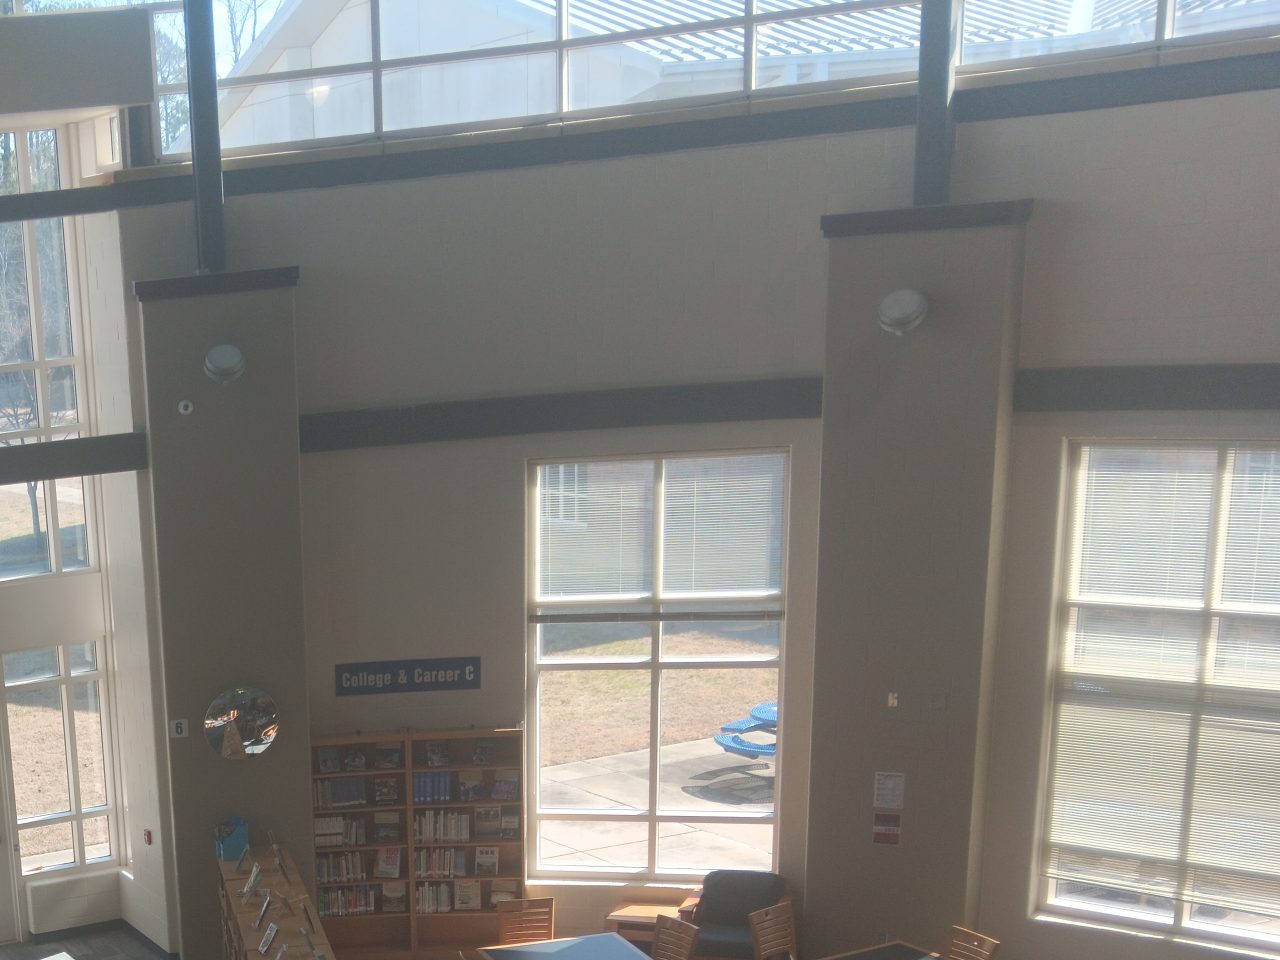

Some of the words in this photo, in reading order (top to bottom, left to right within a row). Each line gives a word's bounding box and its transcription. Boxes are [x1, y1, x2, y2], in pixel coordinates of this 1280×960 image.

[342, 671, 391, 688] College
[398, 669, 408, 684] &
[414, 668, 459, 684] Career
[465, 665, 474, 681] C
[175, 721, 184, 736] 6
